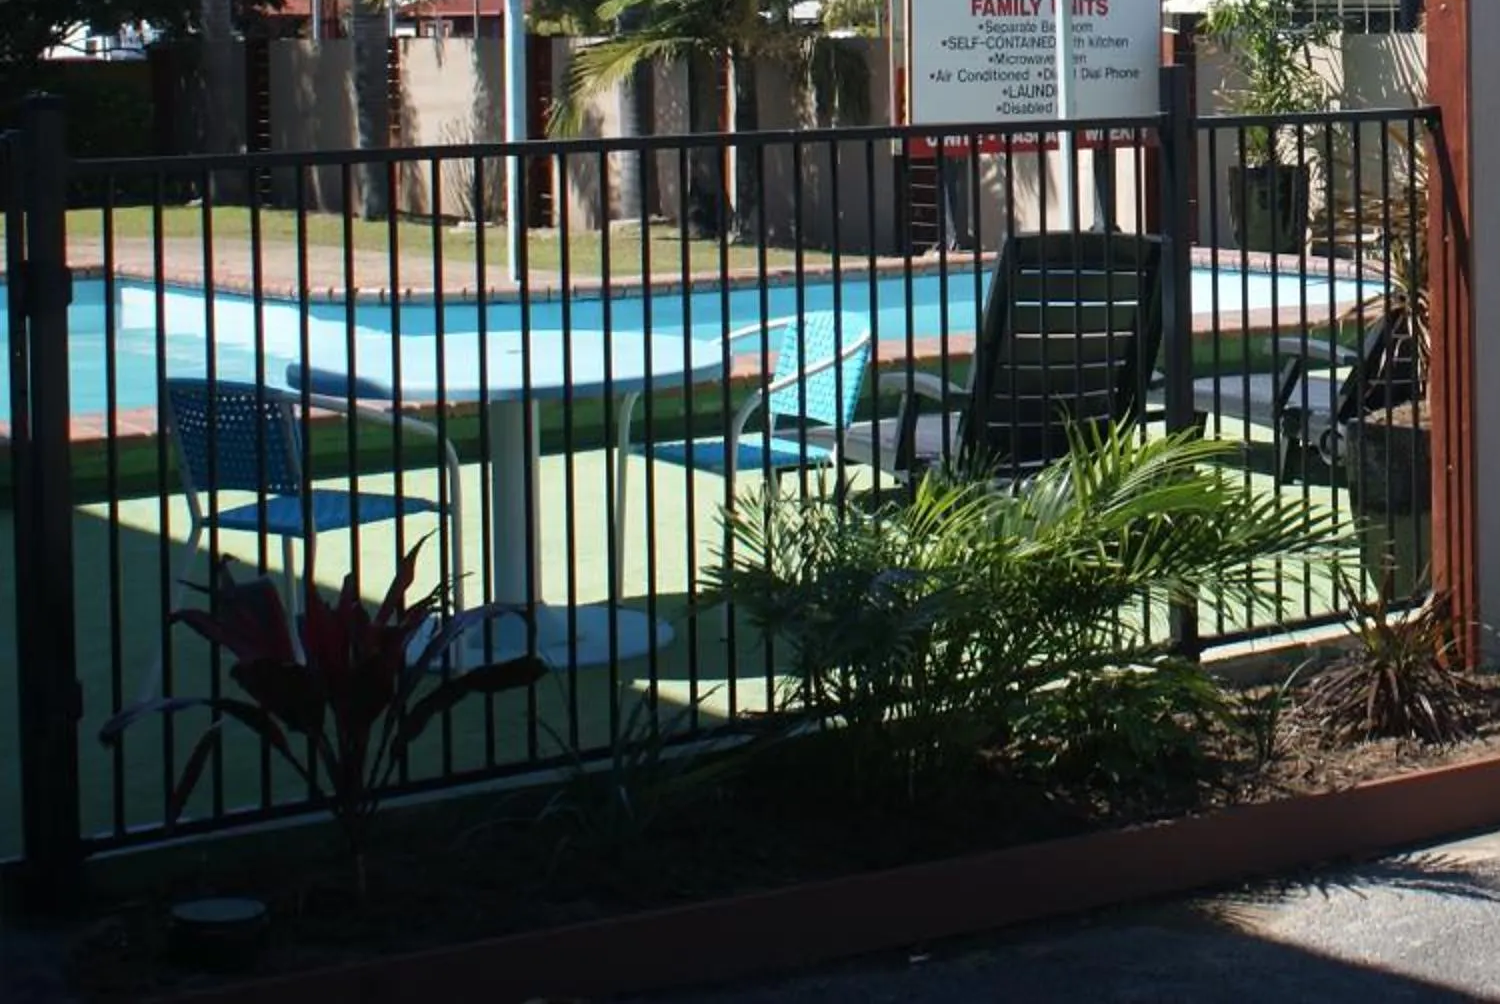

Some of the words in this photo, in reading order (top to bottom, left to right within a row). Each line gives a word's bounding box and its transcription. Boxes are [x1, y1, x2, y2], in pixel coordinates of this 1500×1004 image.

[1041, 21, 1093, 33] Beom
[936, 68, 952, 83] Air
[957, 68, 1030, 83] Conditioned
[1105, 67, 1140, 80] Phone
[1008, 84, 1058, 99] LAUND
